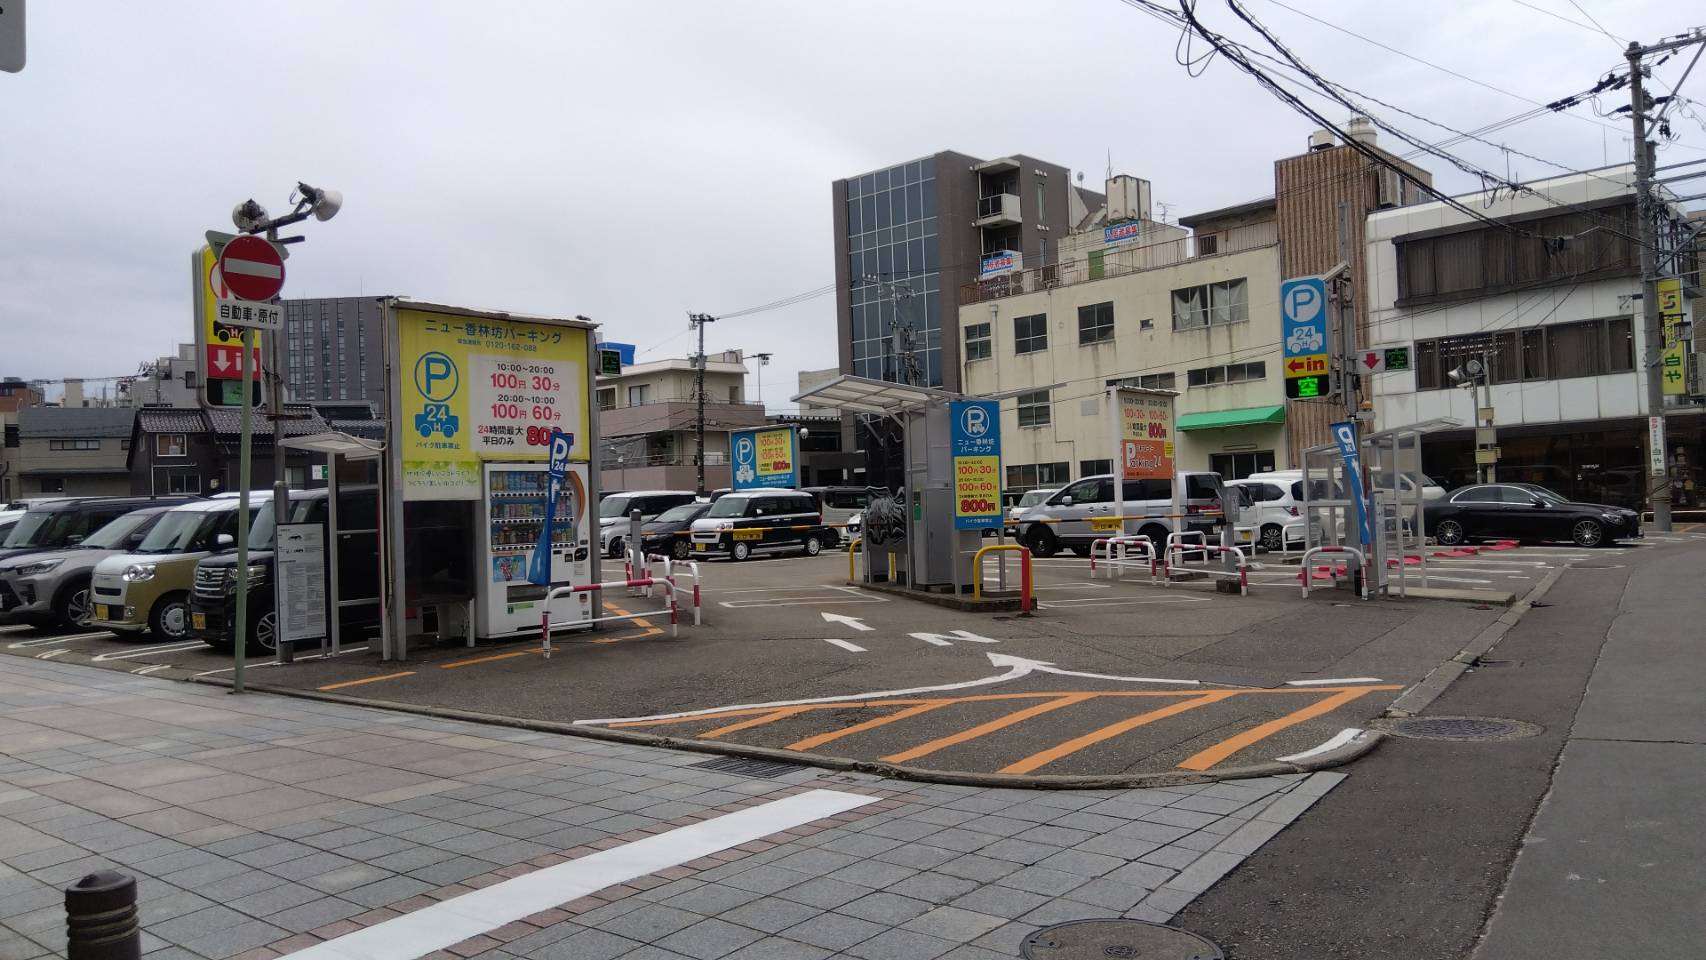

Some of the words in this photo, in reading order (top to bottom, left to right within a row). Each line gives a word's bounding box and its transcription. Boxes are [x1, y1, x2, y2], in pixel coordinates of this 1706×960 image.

[1293, 289, 1315, 318] P
[425, 319, 562, 344] ニュー香林坊パーキング
[1295, 328, 1314, 340] 24
[497, 363, 554, 374] 10:00~20:00
[1306, 357, 1325, 371] in
[425, 357, 451, 395] P
[490, 373, 526, 389] 100円
[532, 376, 560, 391] 30分
[1298, 377, 1319, 397] 空
[498, 394, 555, 404] 20:00~10:00
[426, 406, 448, 421] 24
[491, 404, 527, 419] 100円
[533, 406, 561, 420] 60分
[434, 422, 441, 431] H
[967, 409, 985, 433] P
[478, 425, 523, 436] 24時間最大
[483, 436, 514, 446] 平日のみ
[552, 437, 569, 470] P
[740, 441, 750, 460] P
[961, 499, 996, 512] 800円
